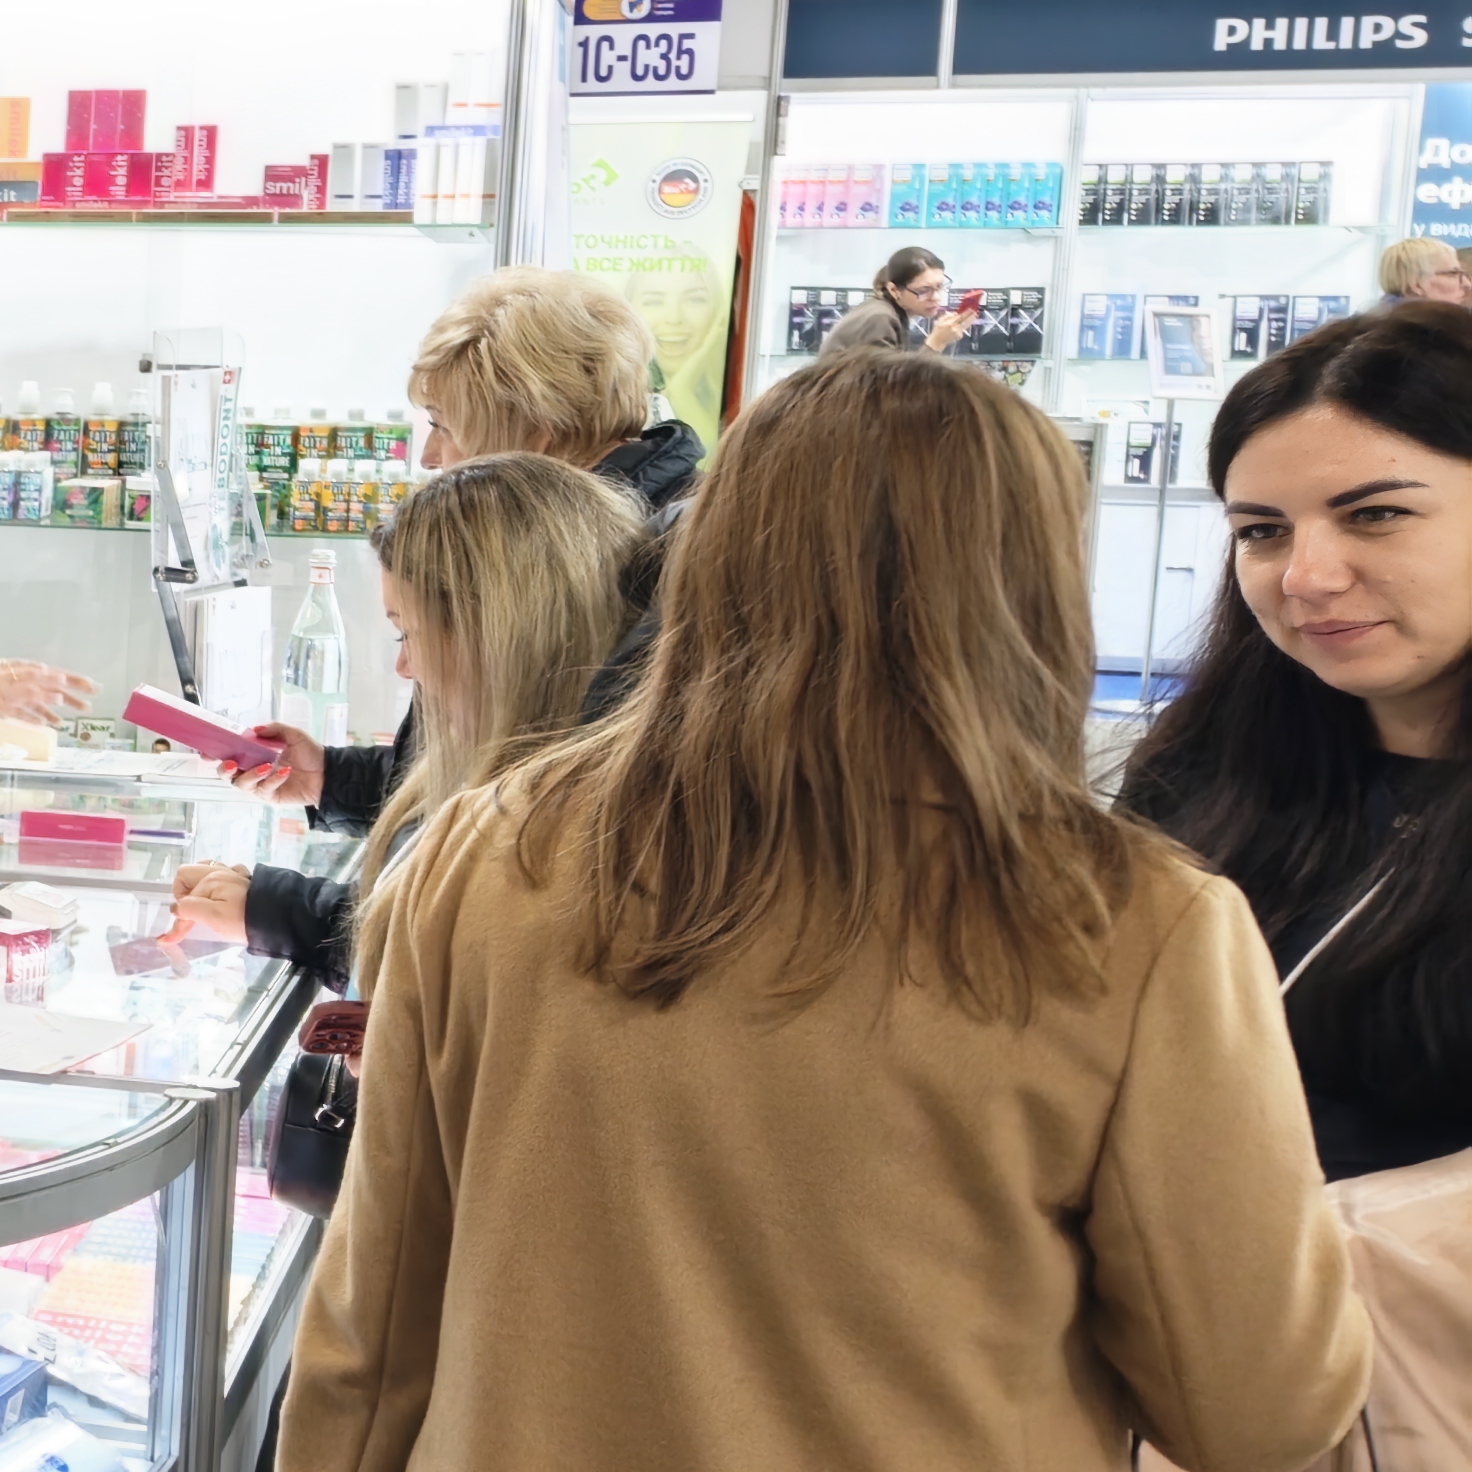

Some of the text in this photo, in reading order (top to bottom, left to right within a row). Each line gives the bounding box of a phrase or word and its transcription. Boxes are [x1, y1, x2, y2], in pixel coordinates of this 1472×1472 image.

[1213, 14, 1428, 51] PHILIPS
[577, 33, 696, 84] 1C-C35
[265, 176, 308, 196] smil
[573, 234, 676, 249] ТОЧНІСТЬ
[586, 257, 624, 272] ВСЕ
